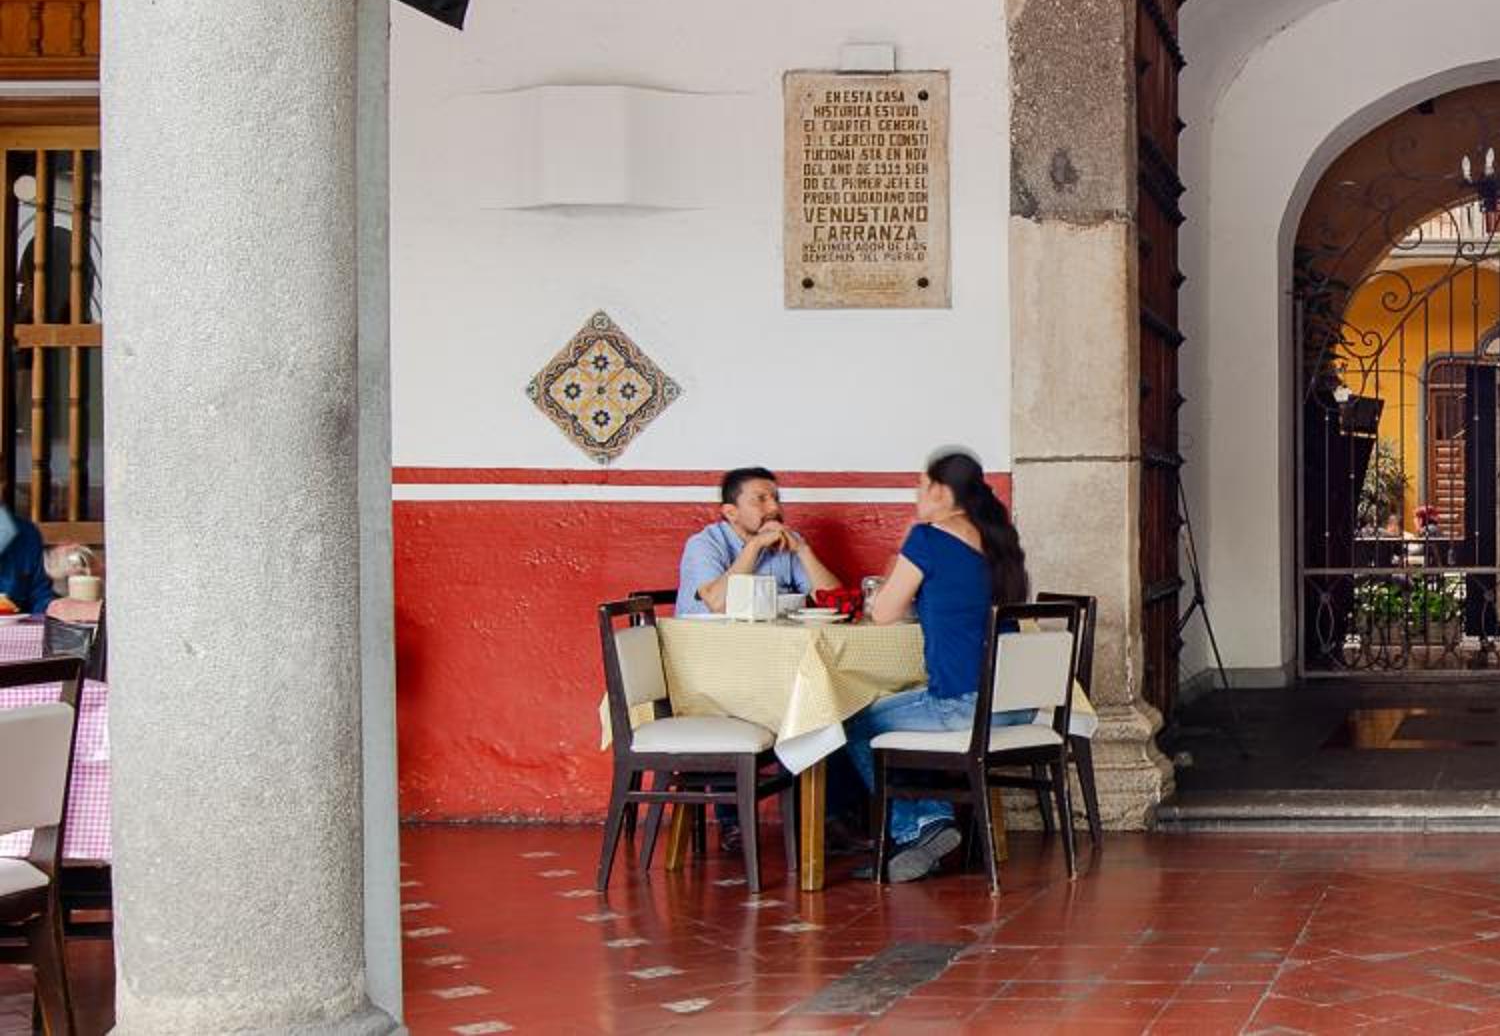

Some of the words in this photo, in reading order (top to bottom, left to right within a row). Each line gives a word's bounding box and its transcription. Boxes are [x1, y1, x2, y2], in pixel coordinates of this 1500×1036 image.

[825, 90, 841, 103] EN
[843, 90, 873, 103] ESTA
[875, 90, 905, 103] CASA
[874, 105, 919, 118] ESTUVO
[878, 119, 929, 133] GENERAL
[803, 134, 826, 147] DL
[889, 134, 929, 147] CONSTI
[886, 148, 901, 161] EN
[803, 163, 826, 176] DEL
[855, 163, 871, 176] DE
[803, 177, 818, 191] DO
[823, 177, 837, 191] EL
[841, 177, 882, 191] PRIMER
[914, 177, 928, 191] EL
[803, 207, 929, 223] VENUSTIANO
[813, 225, 918, 242] CARRANZA
